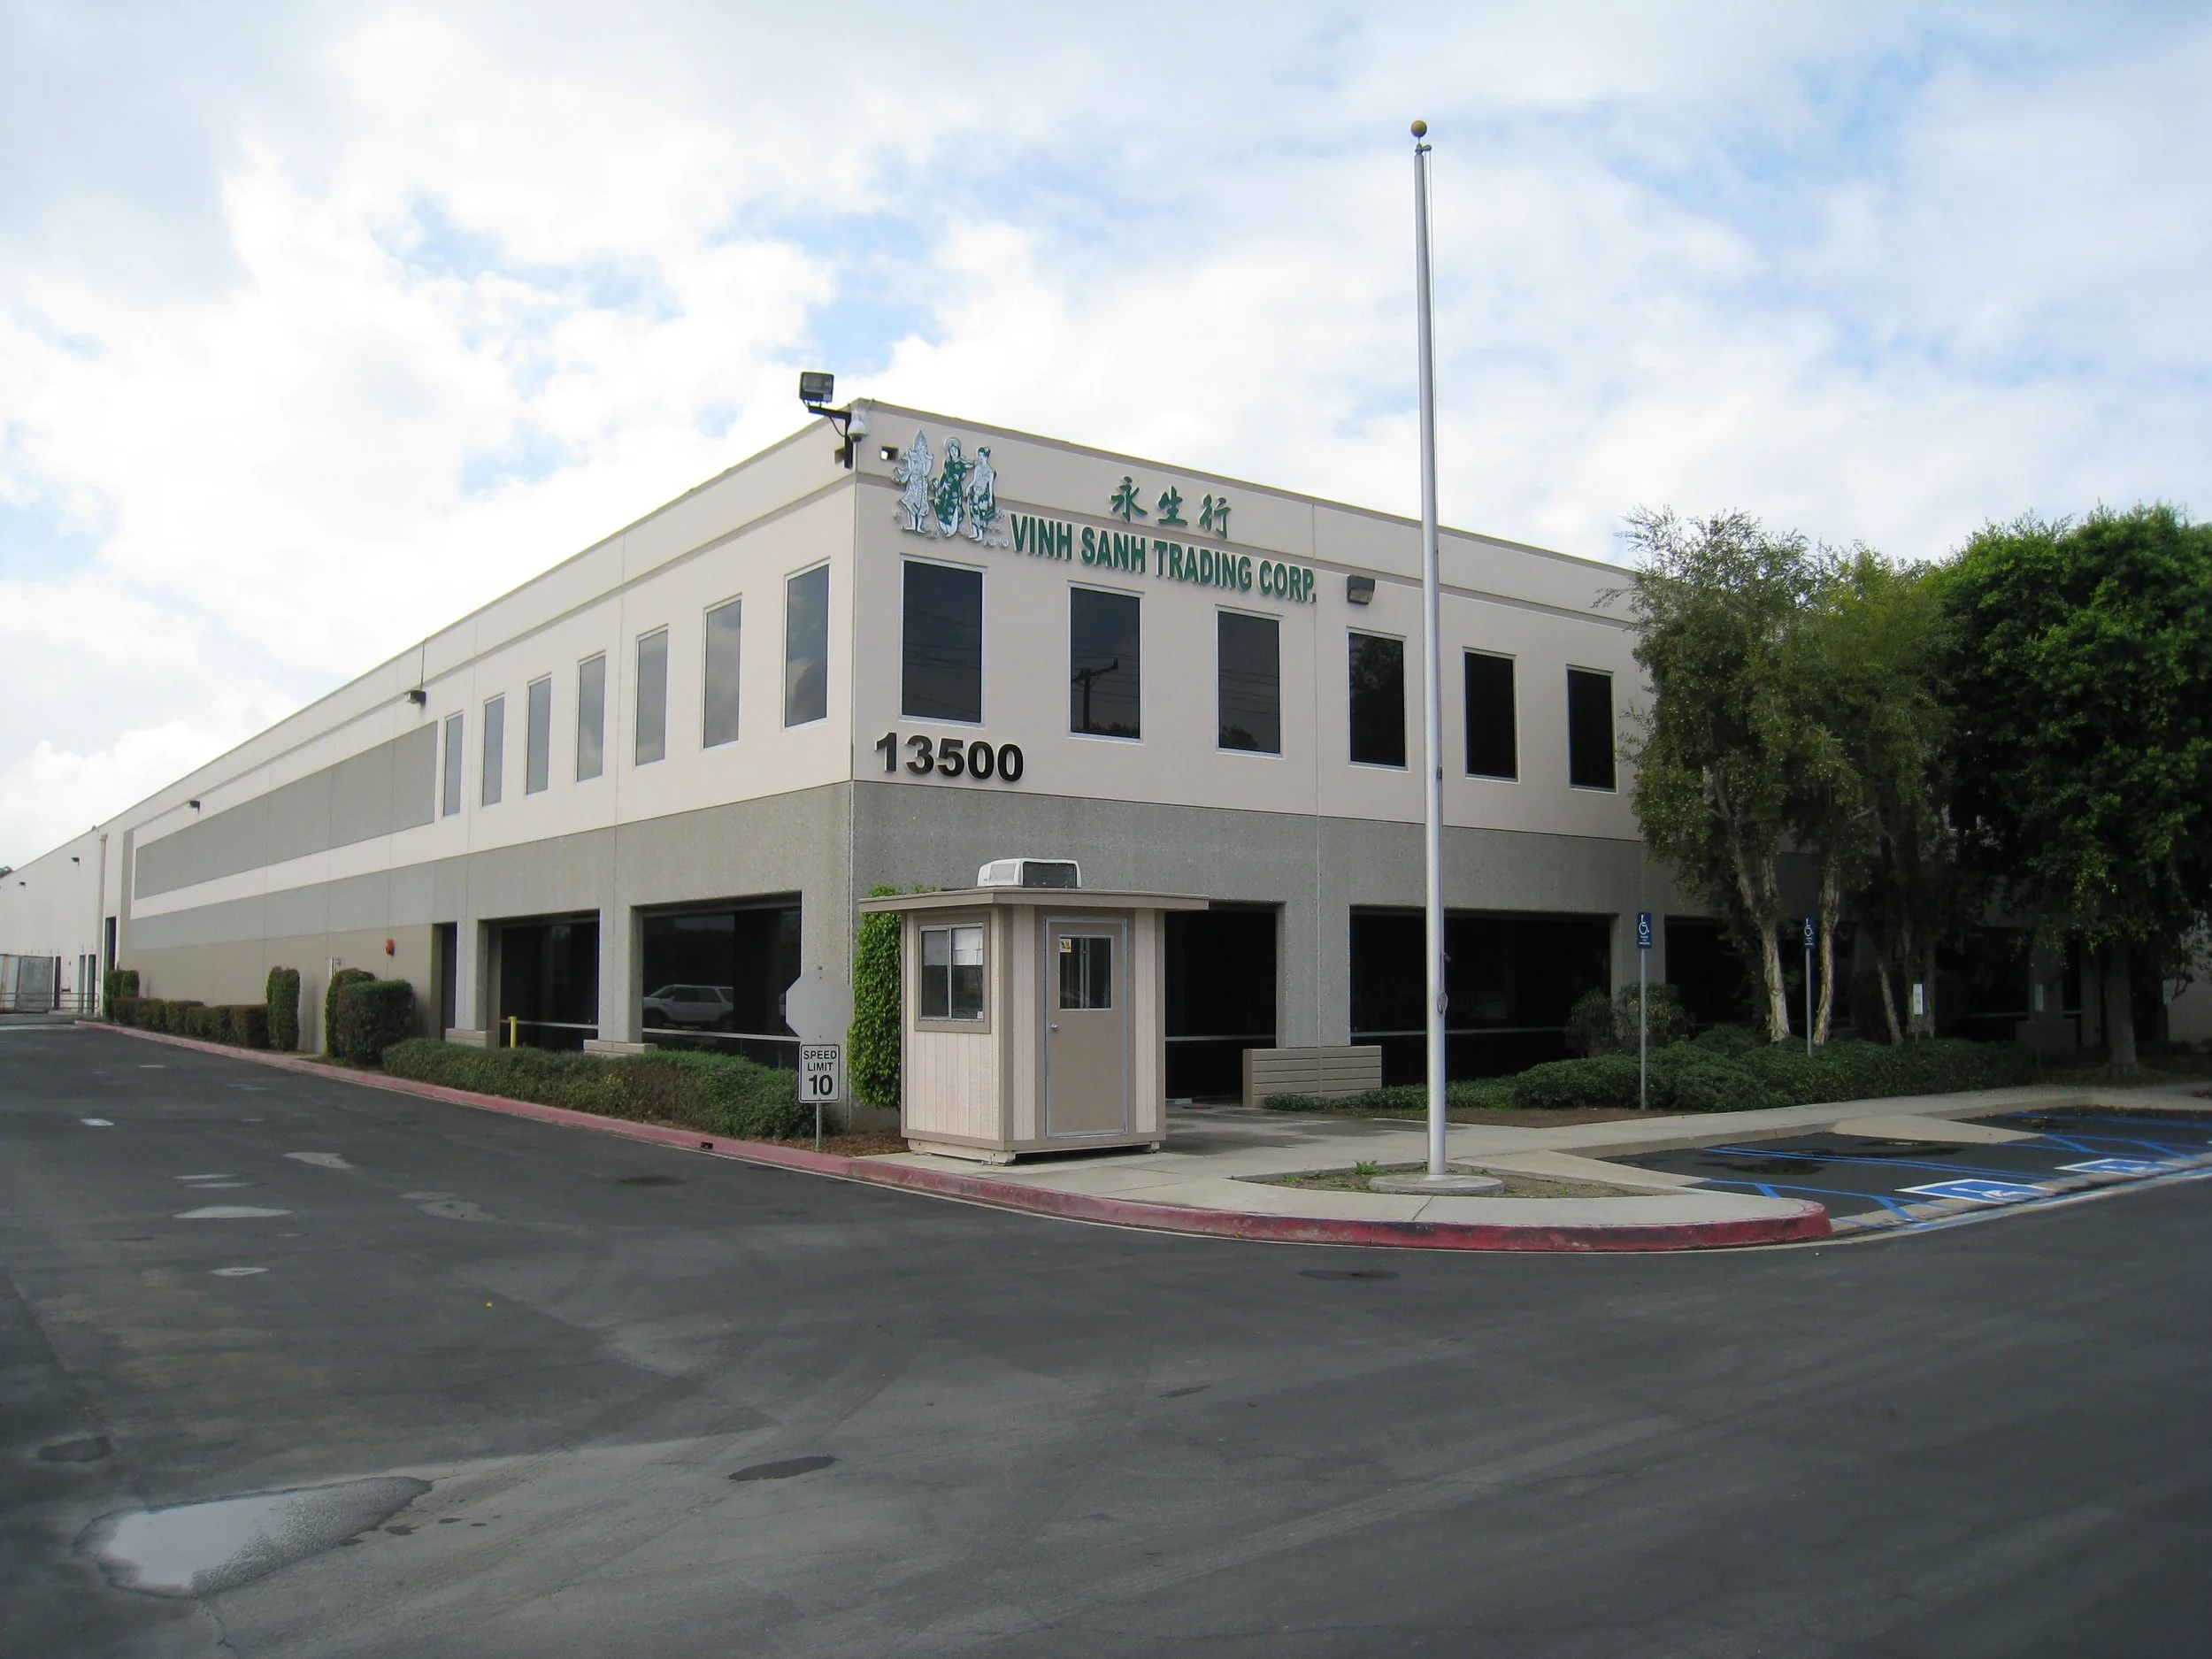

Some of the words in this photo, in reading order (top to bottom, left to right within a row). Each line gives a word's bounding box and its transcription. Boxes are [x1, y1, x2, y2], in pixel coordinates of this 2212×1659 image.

[1110, 475, 1232, 539] 永生行
[1010, 513, 1072, 560] VINH
[1079, 526, 1146, 573] SANH
[1152, 540, 1252, 593] TRADING
[1258, 559, 1317, 603] CORP.
[874, 732, 1024, 781] 13500
[803, 1049, 837, 1059] SPEED
[807, 1062, 833, 1071] LIMIT
[809, 1074, 833, 1095] 10
